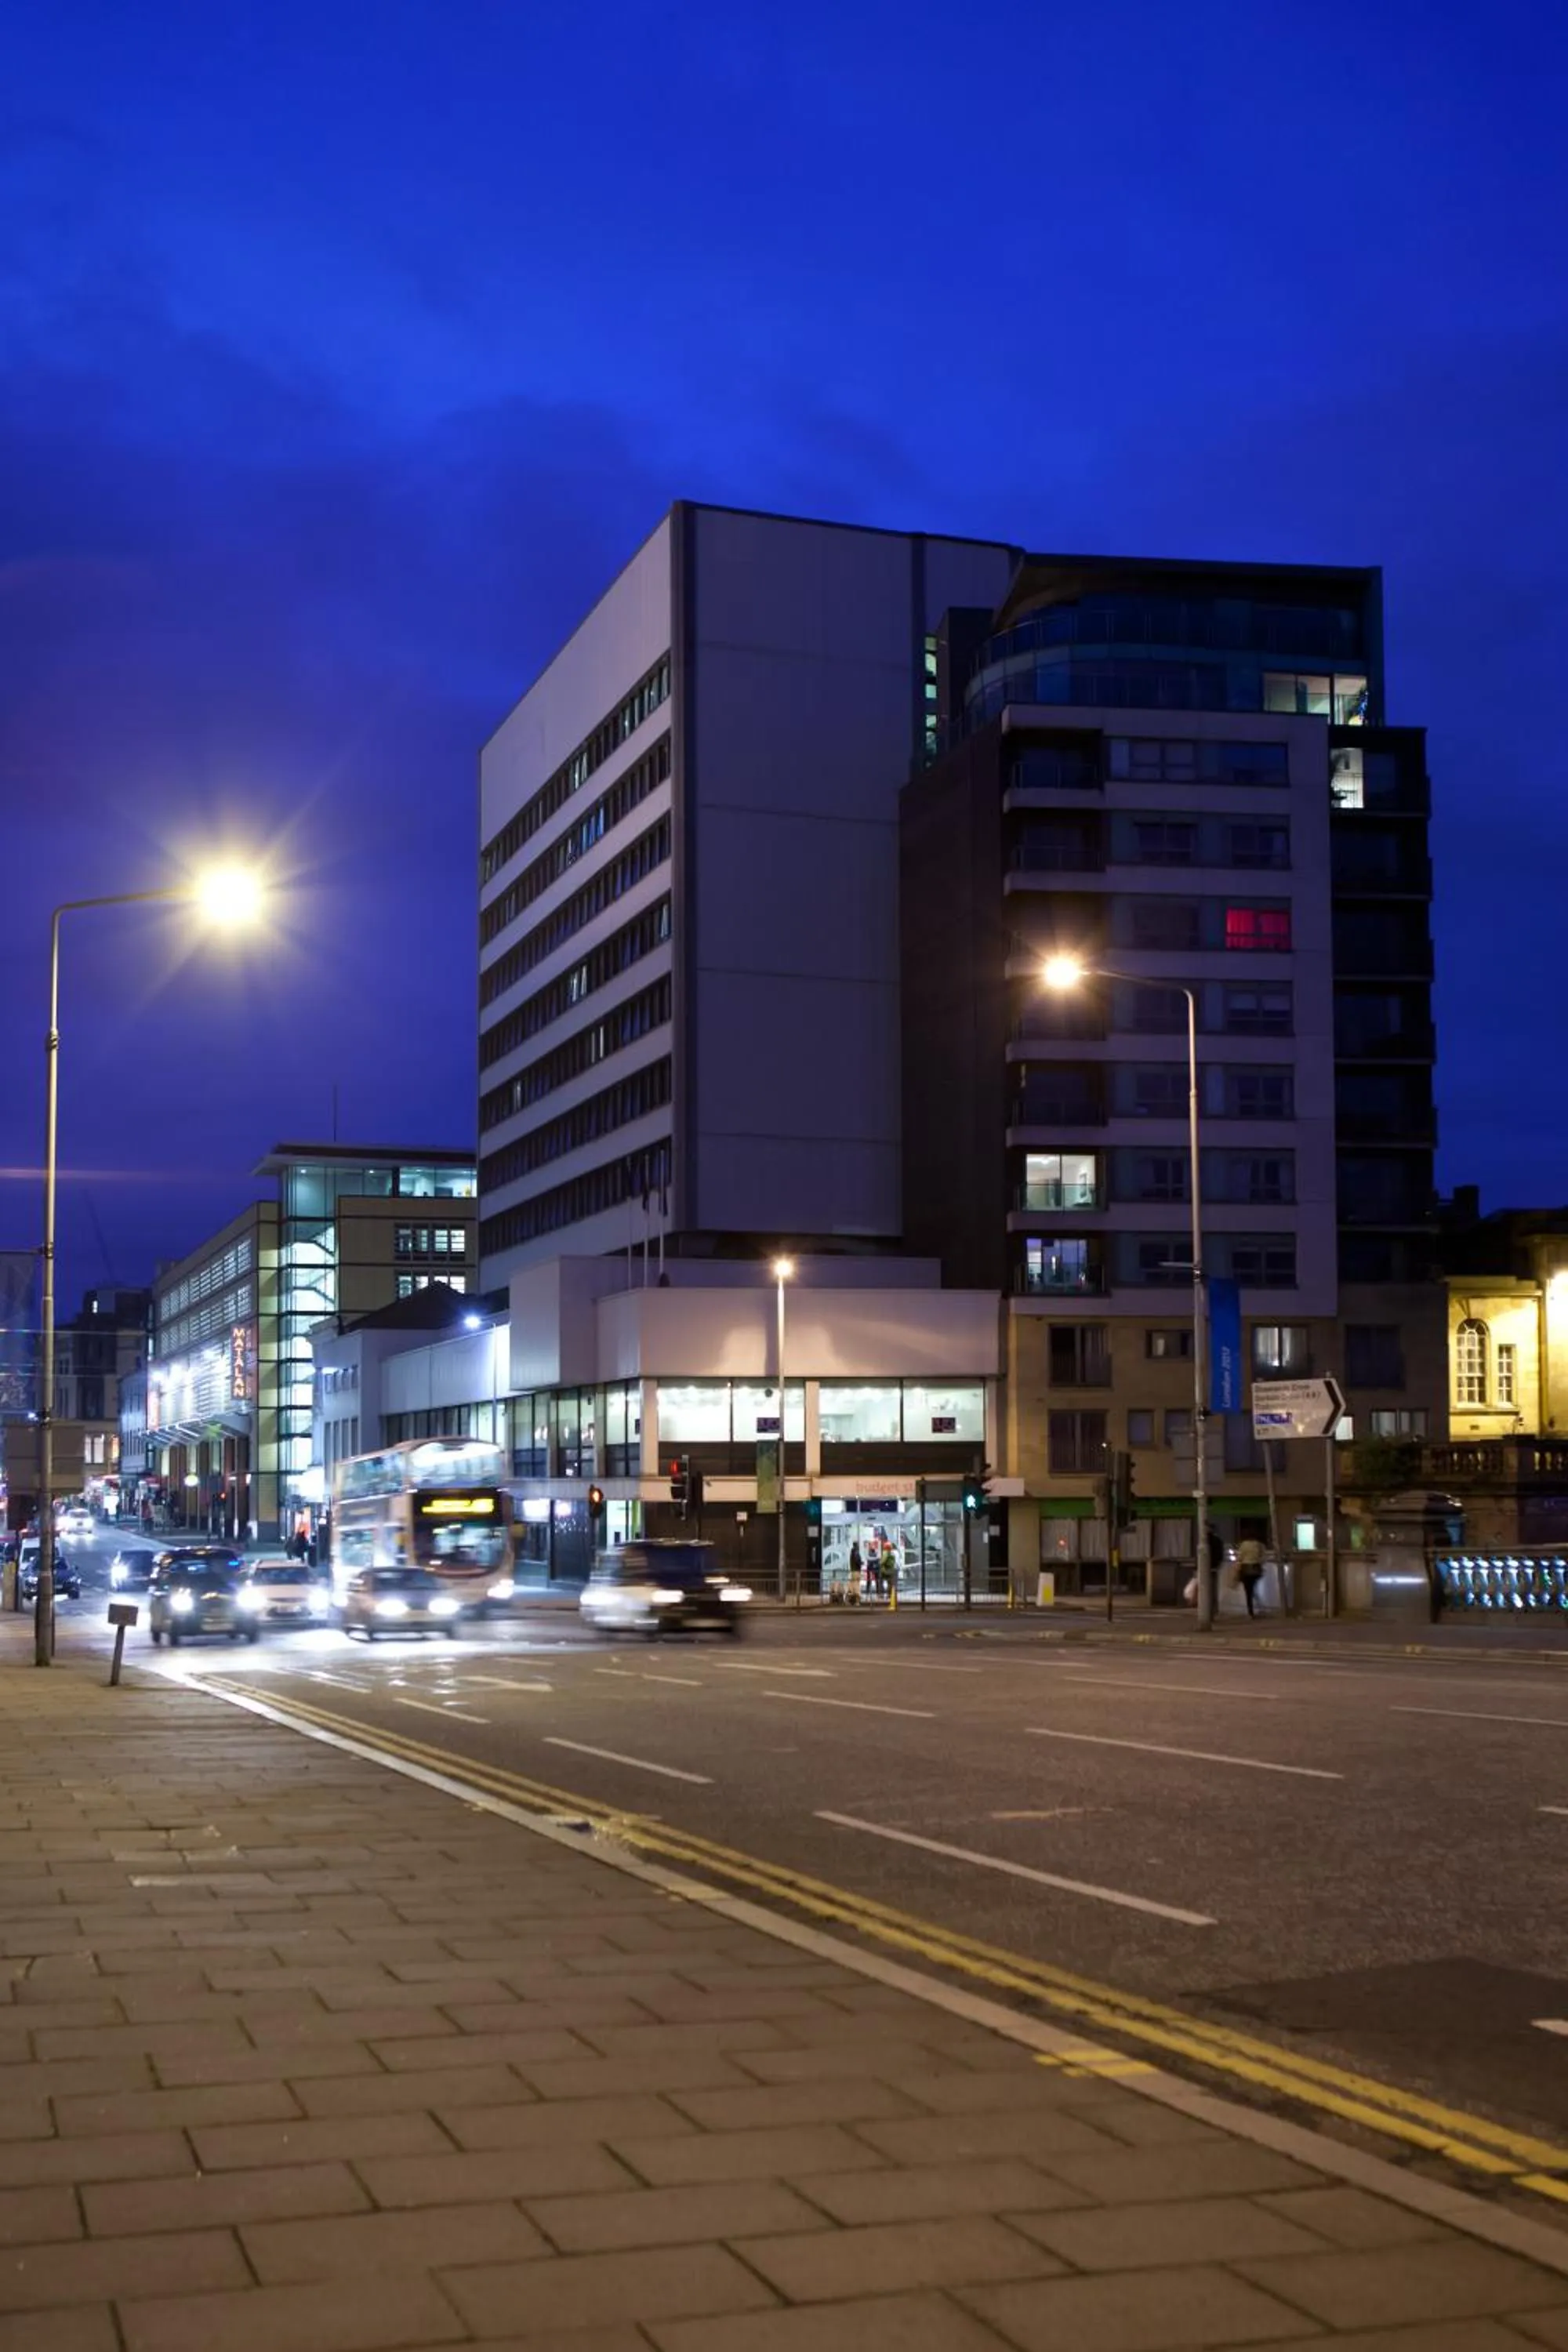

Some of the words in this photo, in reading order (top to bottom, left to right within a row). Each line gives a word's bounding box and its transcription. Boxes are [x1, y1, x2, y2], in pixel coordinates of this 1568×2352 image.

[233, 1328, 245, 1397] MATALAN
[1221, 1371, 1231, 1408] London
[856, 1479, 898, 1494] budget
